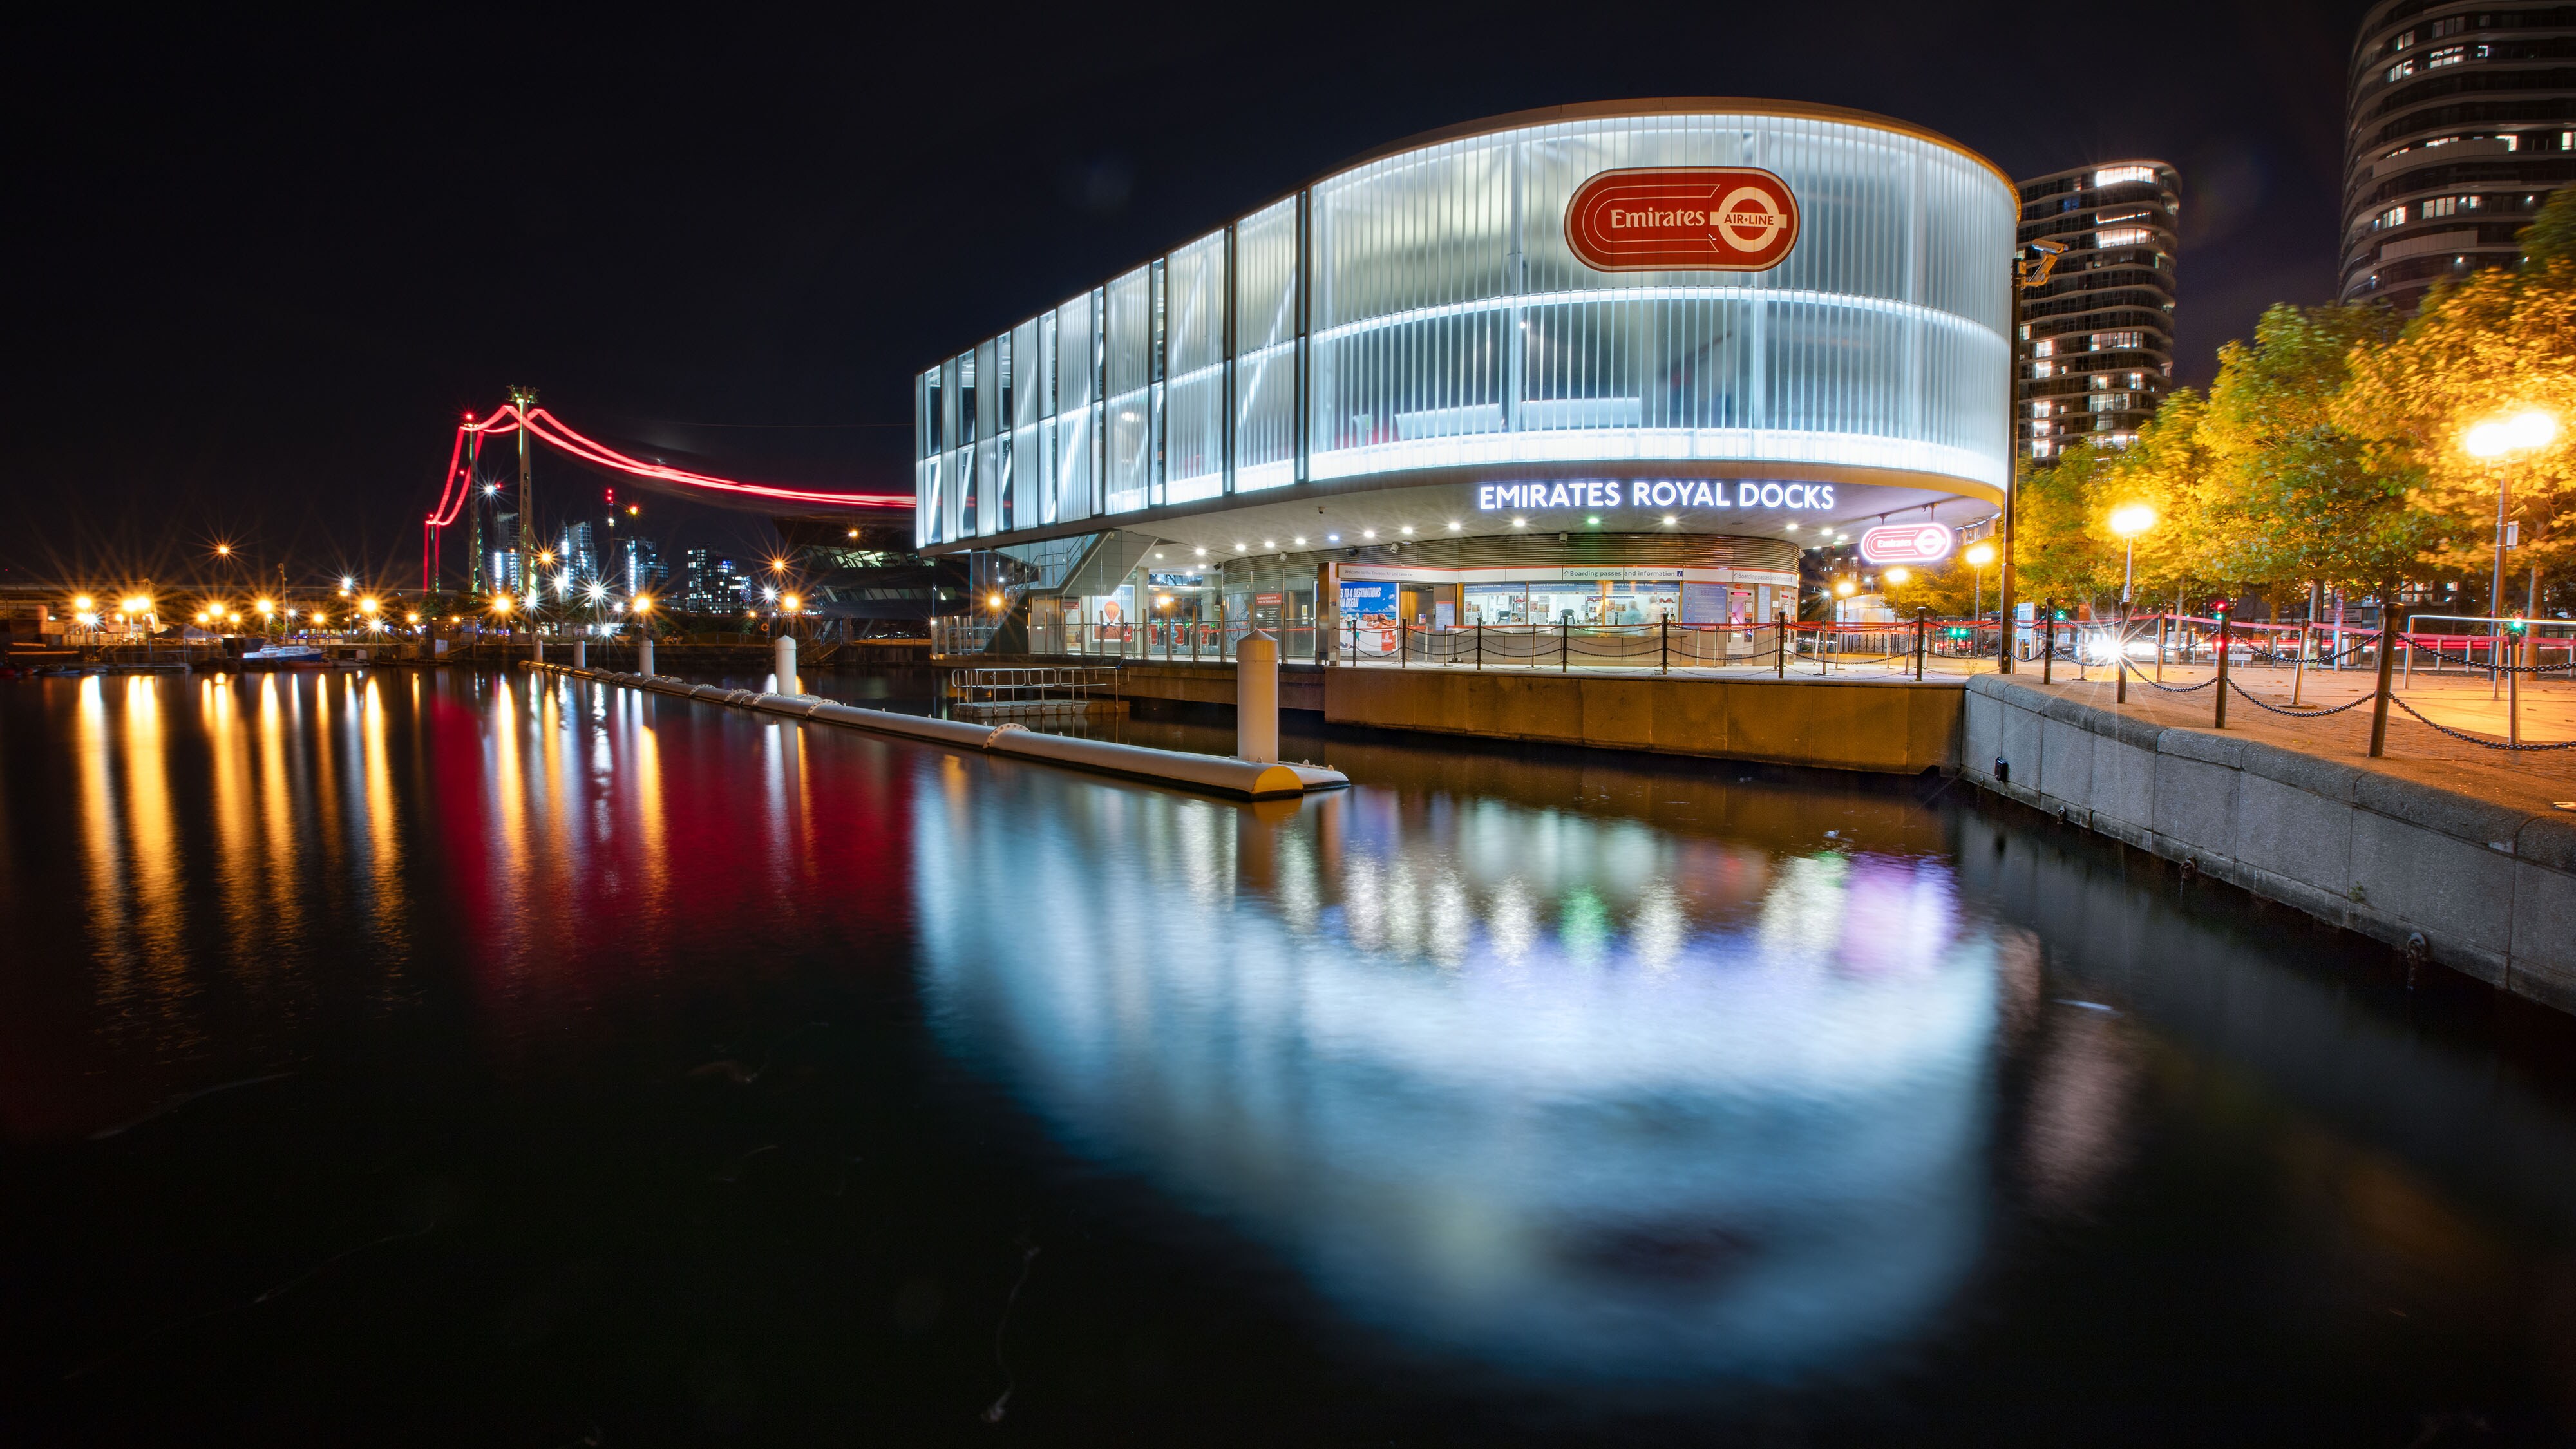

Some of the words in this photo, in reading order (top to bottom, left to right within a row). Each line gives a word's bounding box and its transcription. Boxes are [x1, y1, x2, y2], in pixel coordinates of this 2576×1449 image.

[1611, 207, 1705, 229] Emirates
[1480, 482, 1621, 510] EMIRATES
[1633, 481, 1730, 507] ROYAL
[1739, 483, 1835, 510] DOCKS
[1344, 588, 1349, 598] TO
[1353, 587, 1381, 598] DESTINATIONS
[1346, 598, 1359, 607] OCEAN
